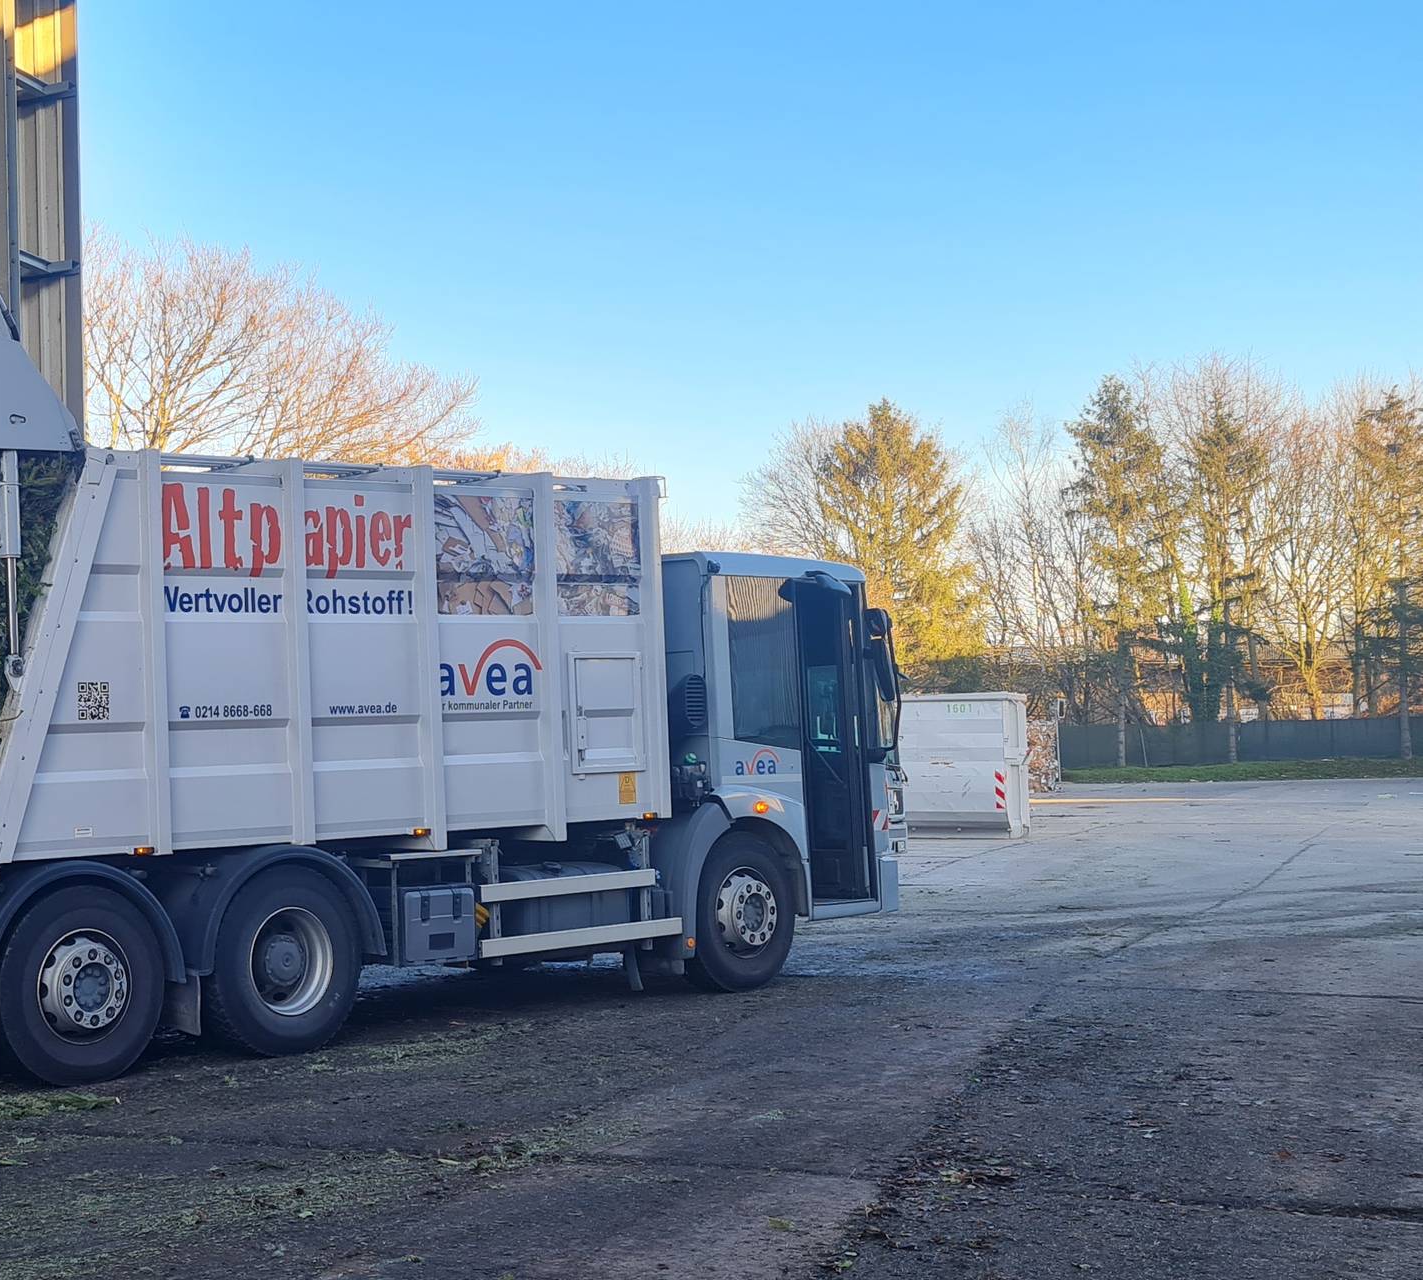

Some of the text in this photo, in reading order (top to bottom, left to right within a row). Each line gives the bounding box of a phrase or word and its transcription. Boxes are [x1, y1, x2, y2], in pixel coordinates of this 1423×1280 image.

[439, 638, 543, 697] avea
[195, 704, 273, 718] 0214 8668-668
[329, 701, 398, 715] www.avea.de
[448, 700, 500, 711] kommunaler
[502, 699, 533, 710] Partner
[735, 748, 779, 776] avea
